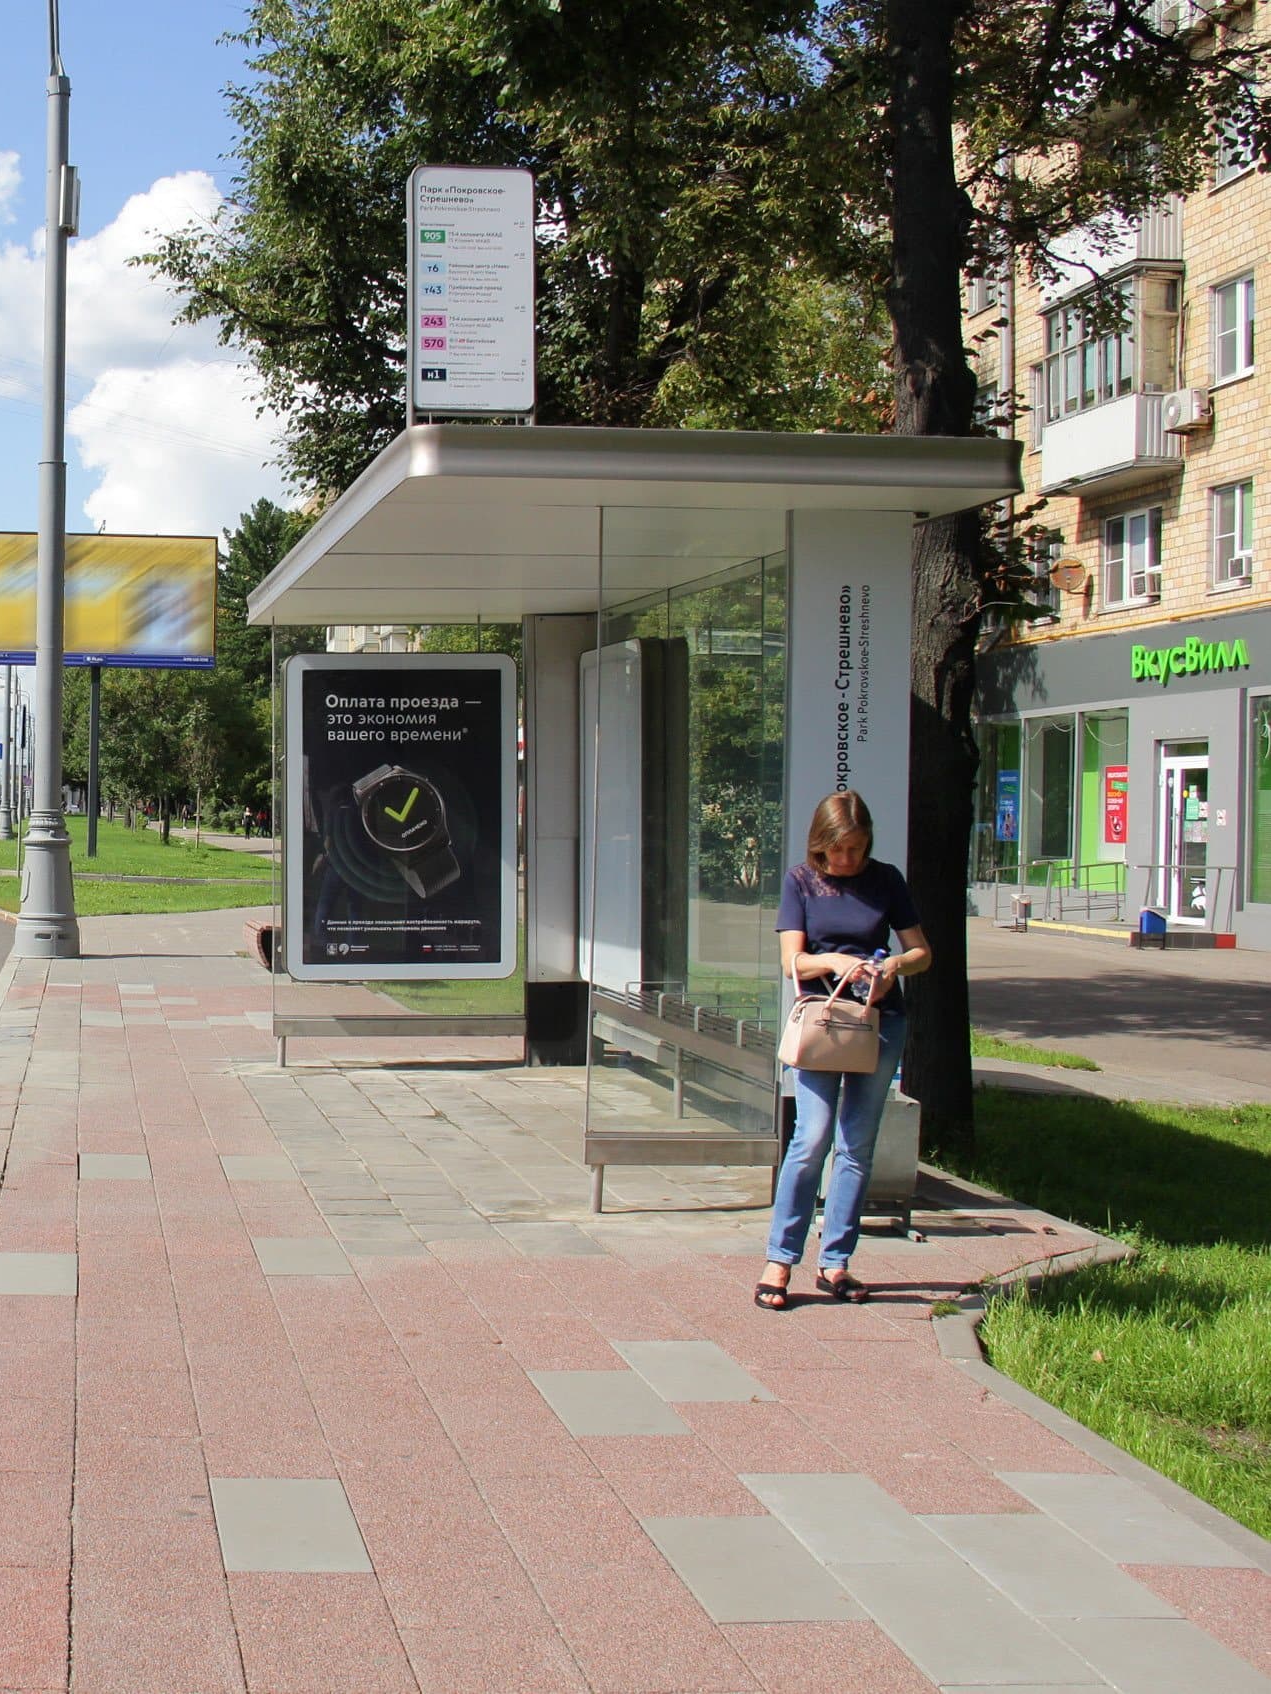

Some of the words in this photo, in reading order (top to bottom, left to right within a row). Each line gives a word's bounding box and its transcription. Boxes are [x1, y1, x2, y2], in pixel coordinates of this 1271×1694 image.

[420, 186, 443, 195] Парк
[424, 231, 441, 241] 905
[424, 317, 443, 327] 243
[424, 339, 444, 349] 570
[835, 585, 854, 690] Стрешнево»
[857, 585, 871, 714] Pokrovskoe-Streshnevo
[1132, 636, 1249, 684] ВкусВилл
[325, 694, 386, 708] Оплата
[390, 697, 459, 710] проезда
[327, 714, 353, 725] это
[358, 714, 437, 725] экономия
[327, 730, 386, 741] вашего
[857, 716, 867, 742] Park
[836, 702, 851, 792] окровское
